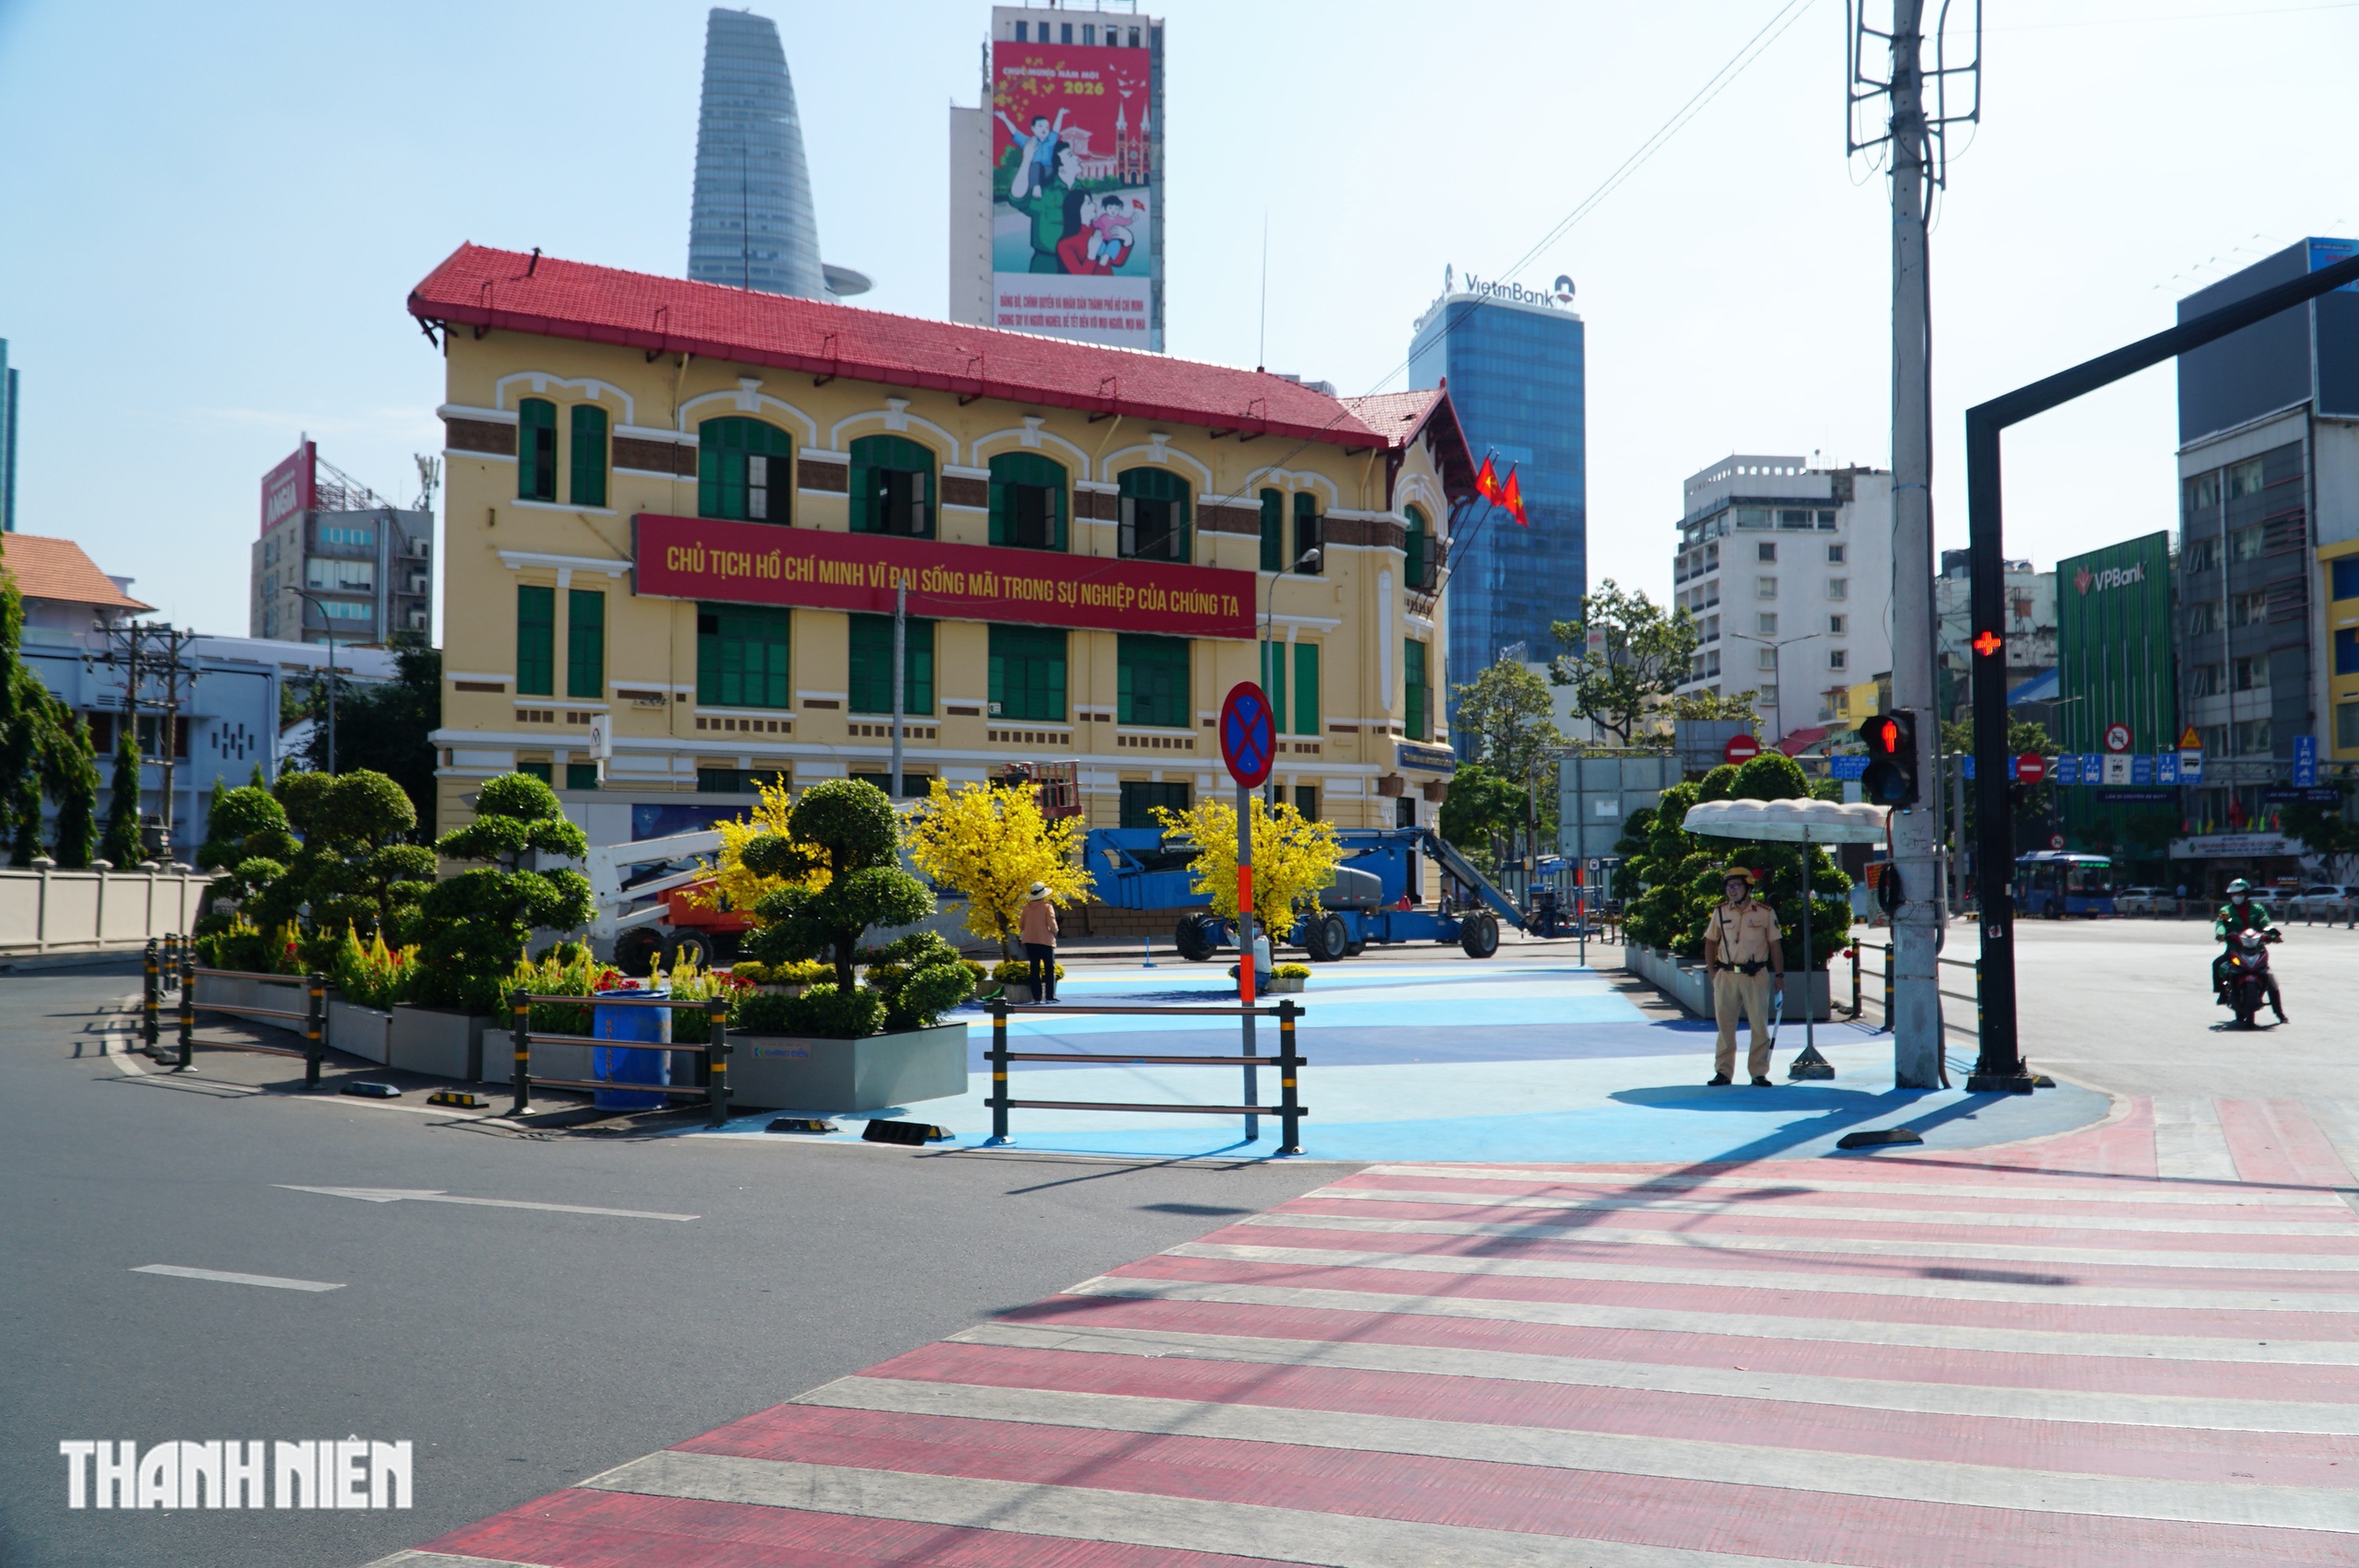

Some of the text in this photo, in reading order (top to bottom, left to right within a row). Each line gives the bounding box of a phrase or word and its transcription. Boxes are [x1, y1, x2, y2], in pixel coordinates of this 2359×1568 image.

[1063, 80, 1105, 95] 2026
[667, 541, 705, 573] CHỦ
[709, 550, 751, 579] TỊCH
[756, 549, 781, 579] HỒ
[784, 555, 816, 582] CHÍ
[818, 559, 864, 587] MINH
[868, 561, 887, 588] VĨ
[921, 564, 965, 595] SỐNG
[968, 570, 999, 598] MÃI
[1002, 577, 1054, 603] TRONG
[1057, 581, 1078, 608] SỰ
[1081, 582, 1135, 612] NGHIỆP
[1138, 582, 1167, 612] CỦA
[1170, 589, 1218, 615] CHÚNG
[1221, 595, 1239, 617] TA
[2095, 561, 2147, 591] VPBank
